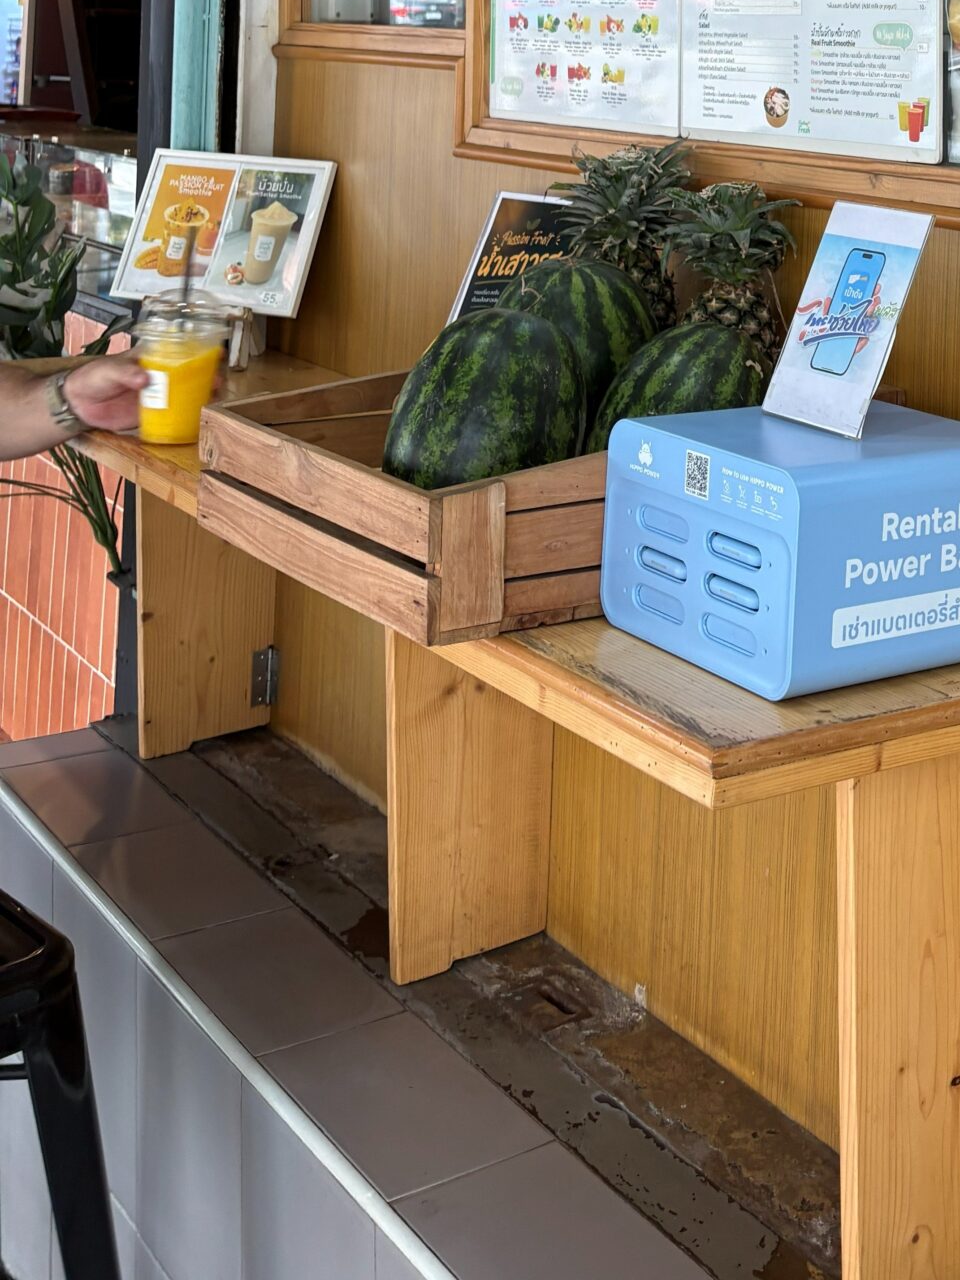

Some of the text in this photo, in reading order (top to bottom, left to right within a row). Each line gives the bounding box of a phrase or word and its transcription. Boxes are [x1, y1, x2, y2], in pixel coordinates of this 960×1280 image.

[500, 230, 556, 247] Passion Fruit
[845, 552, 931, 589] Power
